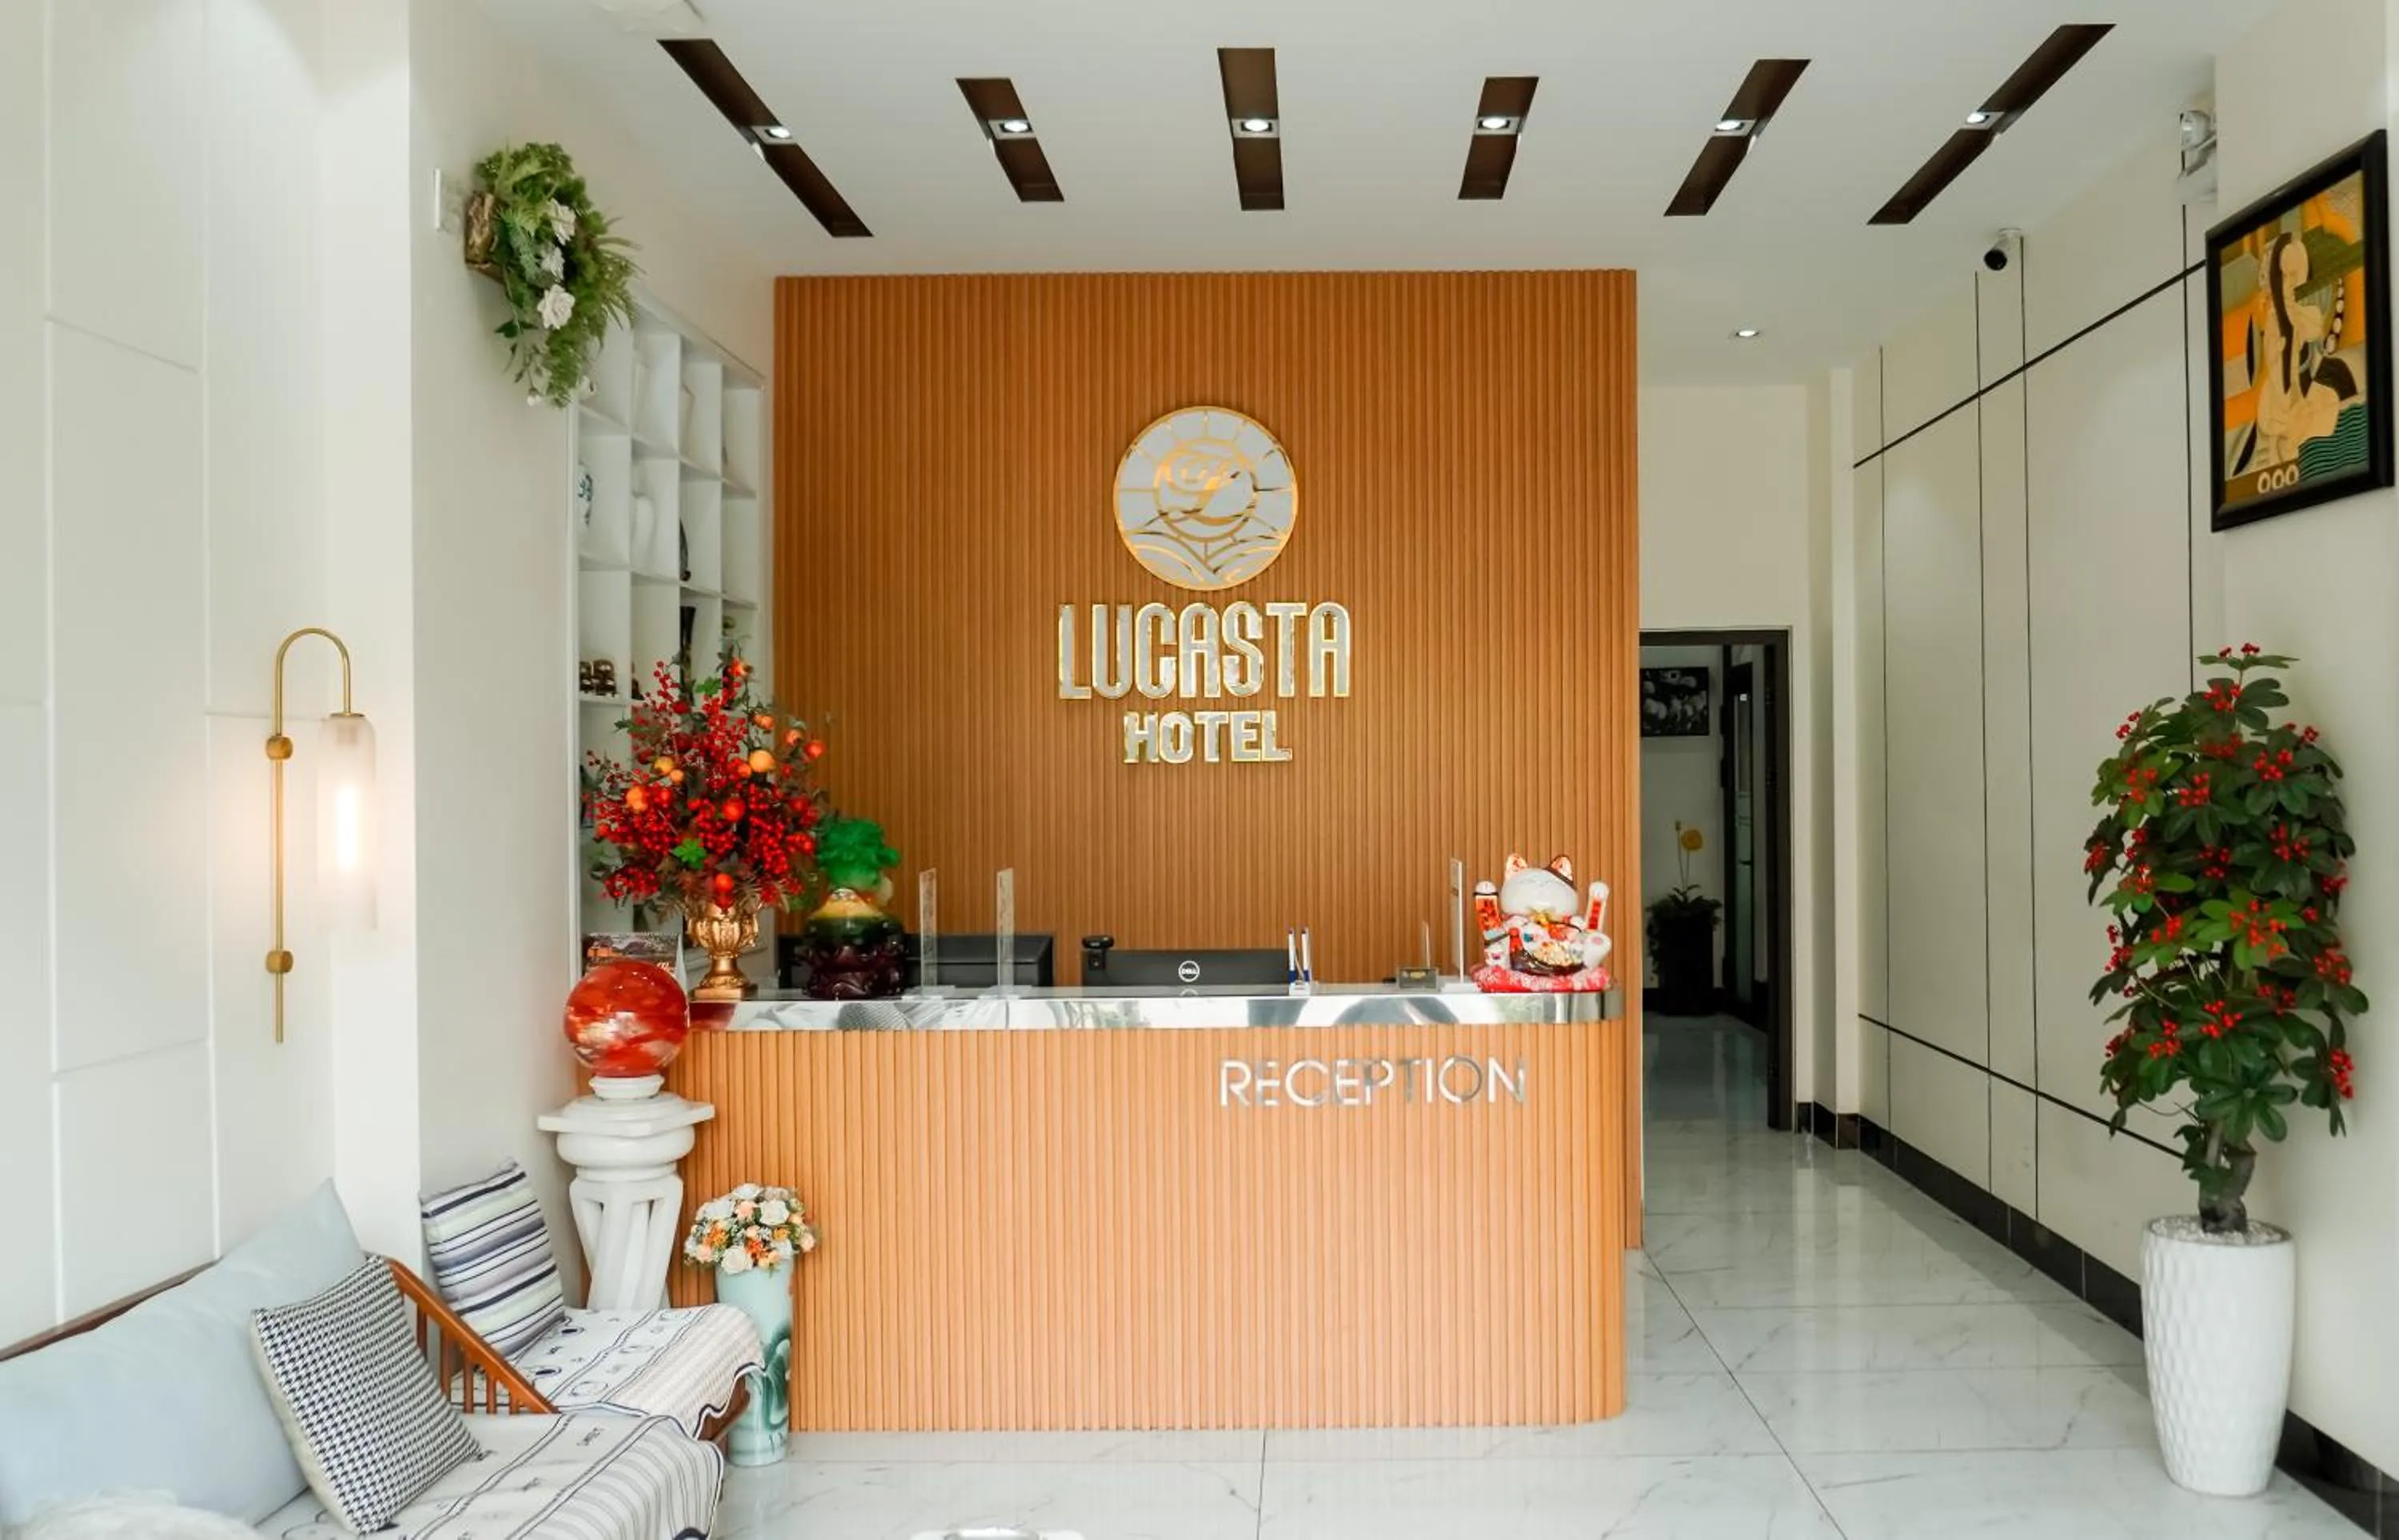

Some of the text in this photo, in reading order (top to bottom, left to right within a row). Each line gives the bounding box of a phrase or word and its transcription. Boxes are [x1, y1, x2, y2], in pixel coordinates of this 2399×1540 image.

[1058, 600, 1351, 700] LUCASTA
[1123, 710, 1293, 764] HOTEL
[1219, 1054, 1527, 1107] RECEPTION
